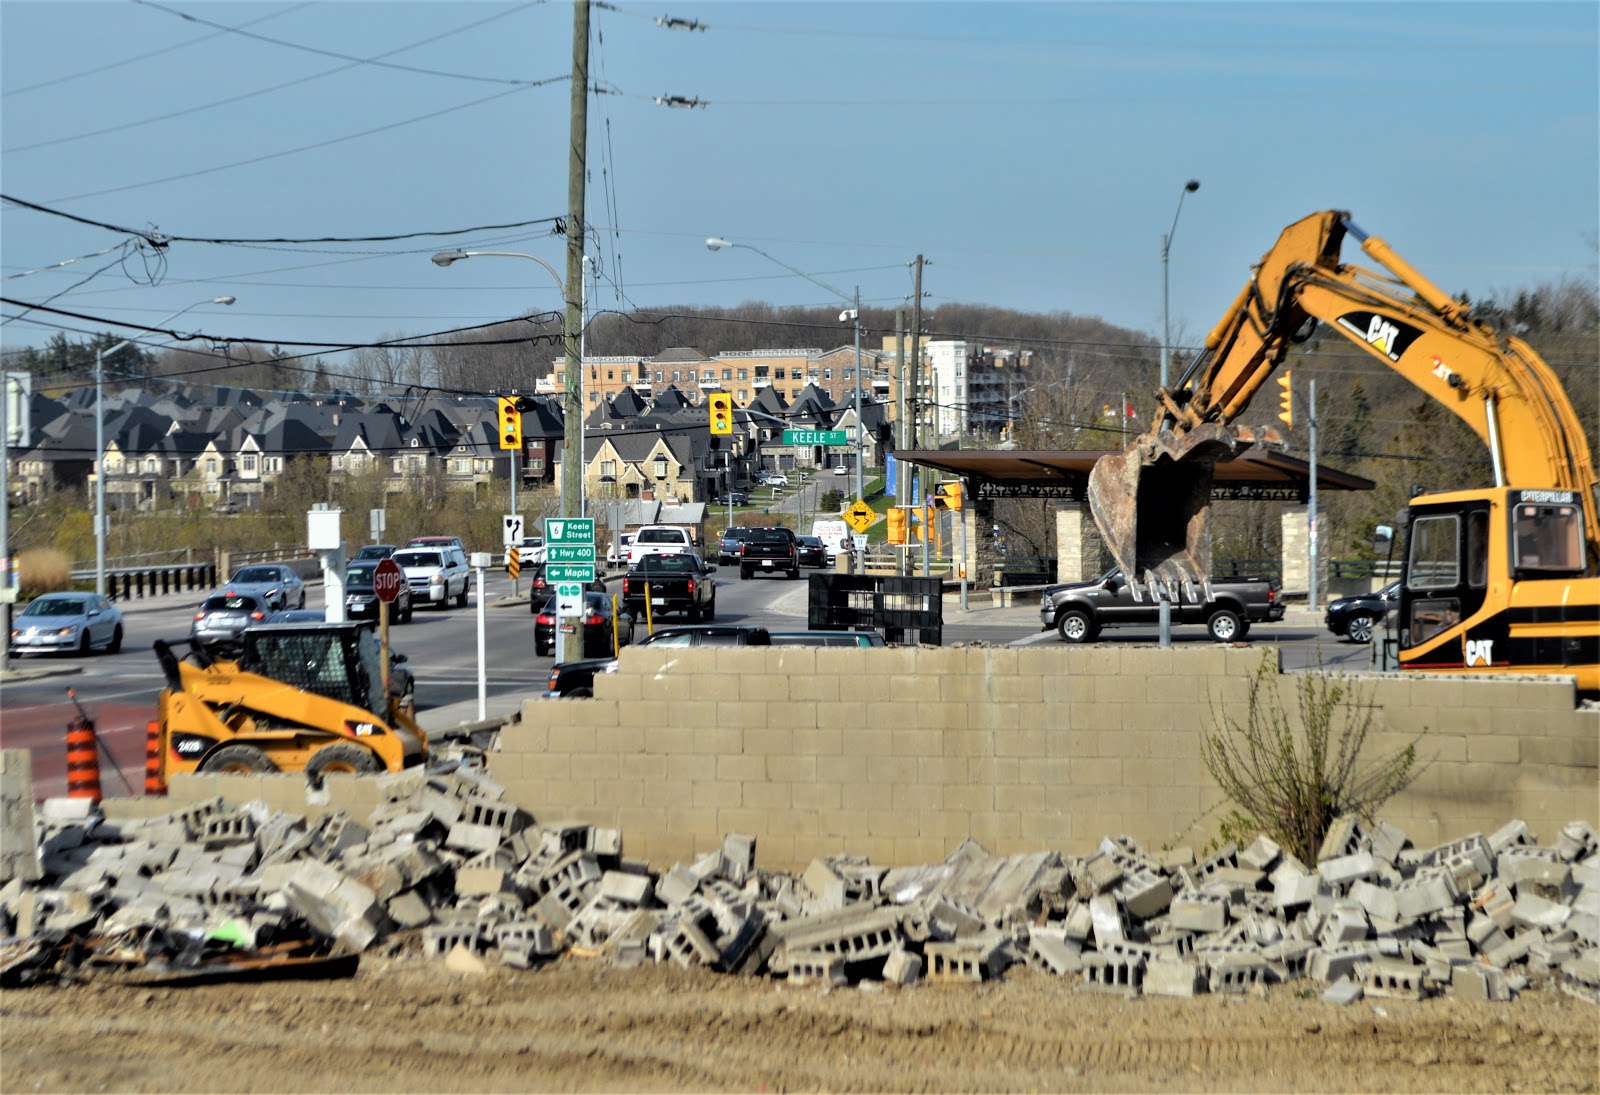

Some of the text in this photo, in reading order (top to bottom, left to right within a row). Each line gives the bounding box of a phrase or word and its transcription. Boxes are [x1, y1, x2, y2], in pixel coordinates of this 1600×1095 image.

[1367, 315, 1399, 355] CAT
[792, 432, 826, 443] KEELE
[1520, 490, 1573, 503] CATERPILLAR
[554, 526, 559, 534] 6
[566, 531, 591, 539] Street
[560, 549, 591, 558] Hwy 400
[565, 569, 590, 578] Maple
[376, 572, 400, 589] STOP
[558, 585, 580, 596] GO
[1466, 639, 1494, 667] CAT
[356, 723, 373, 736] CAT
